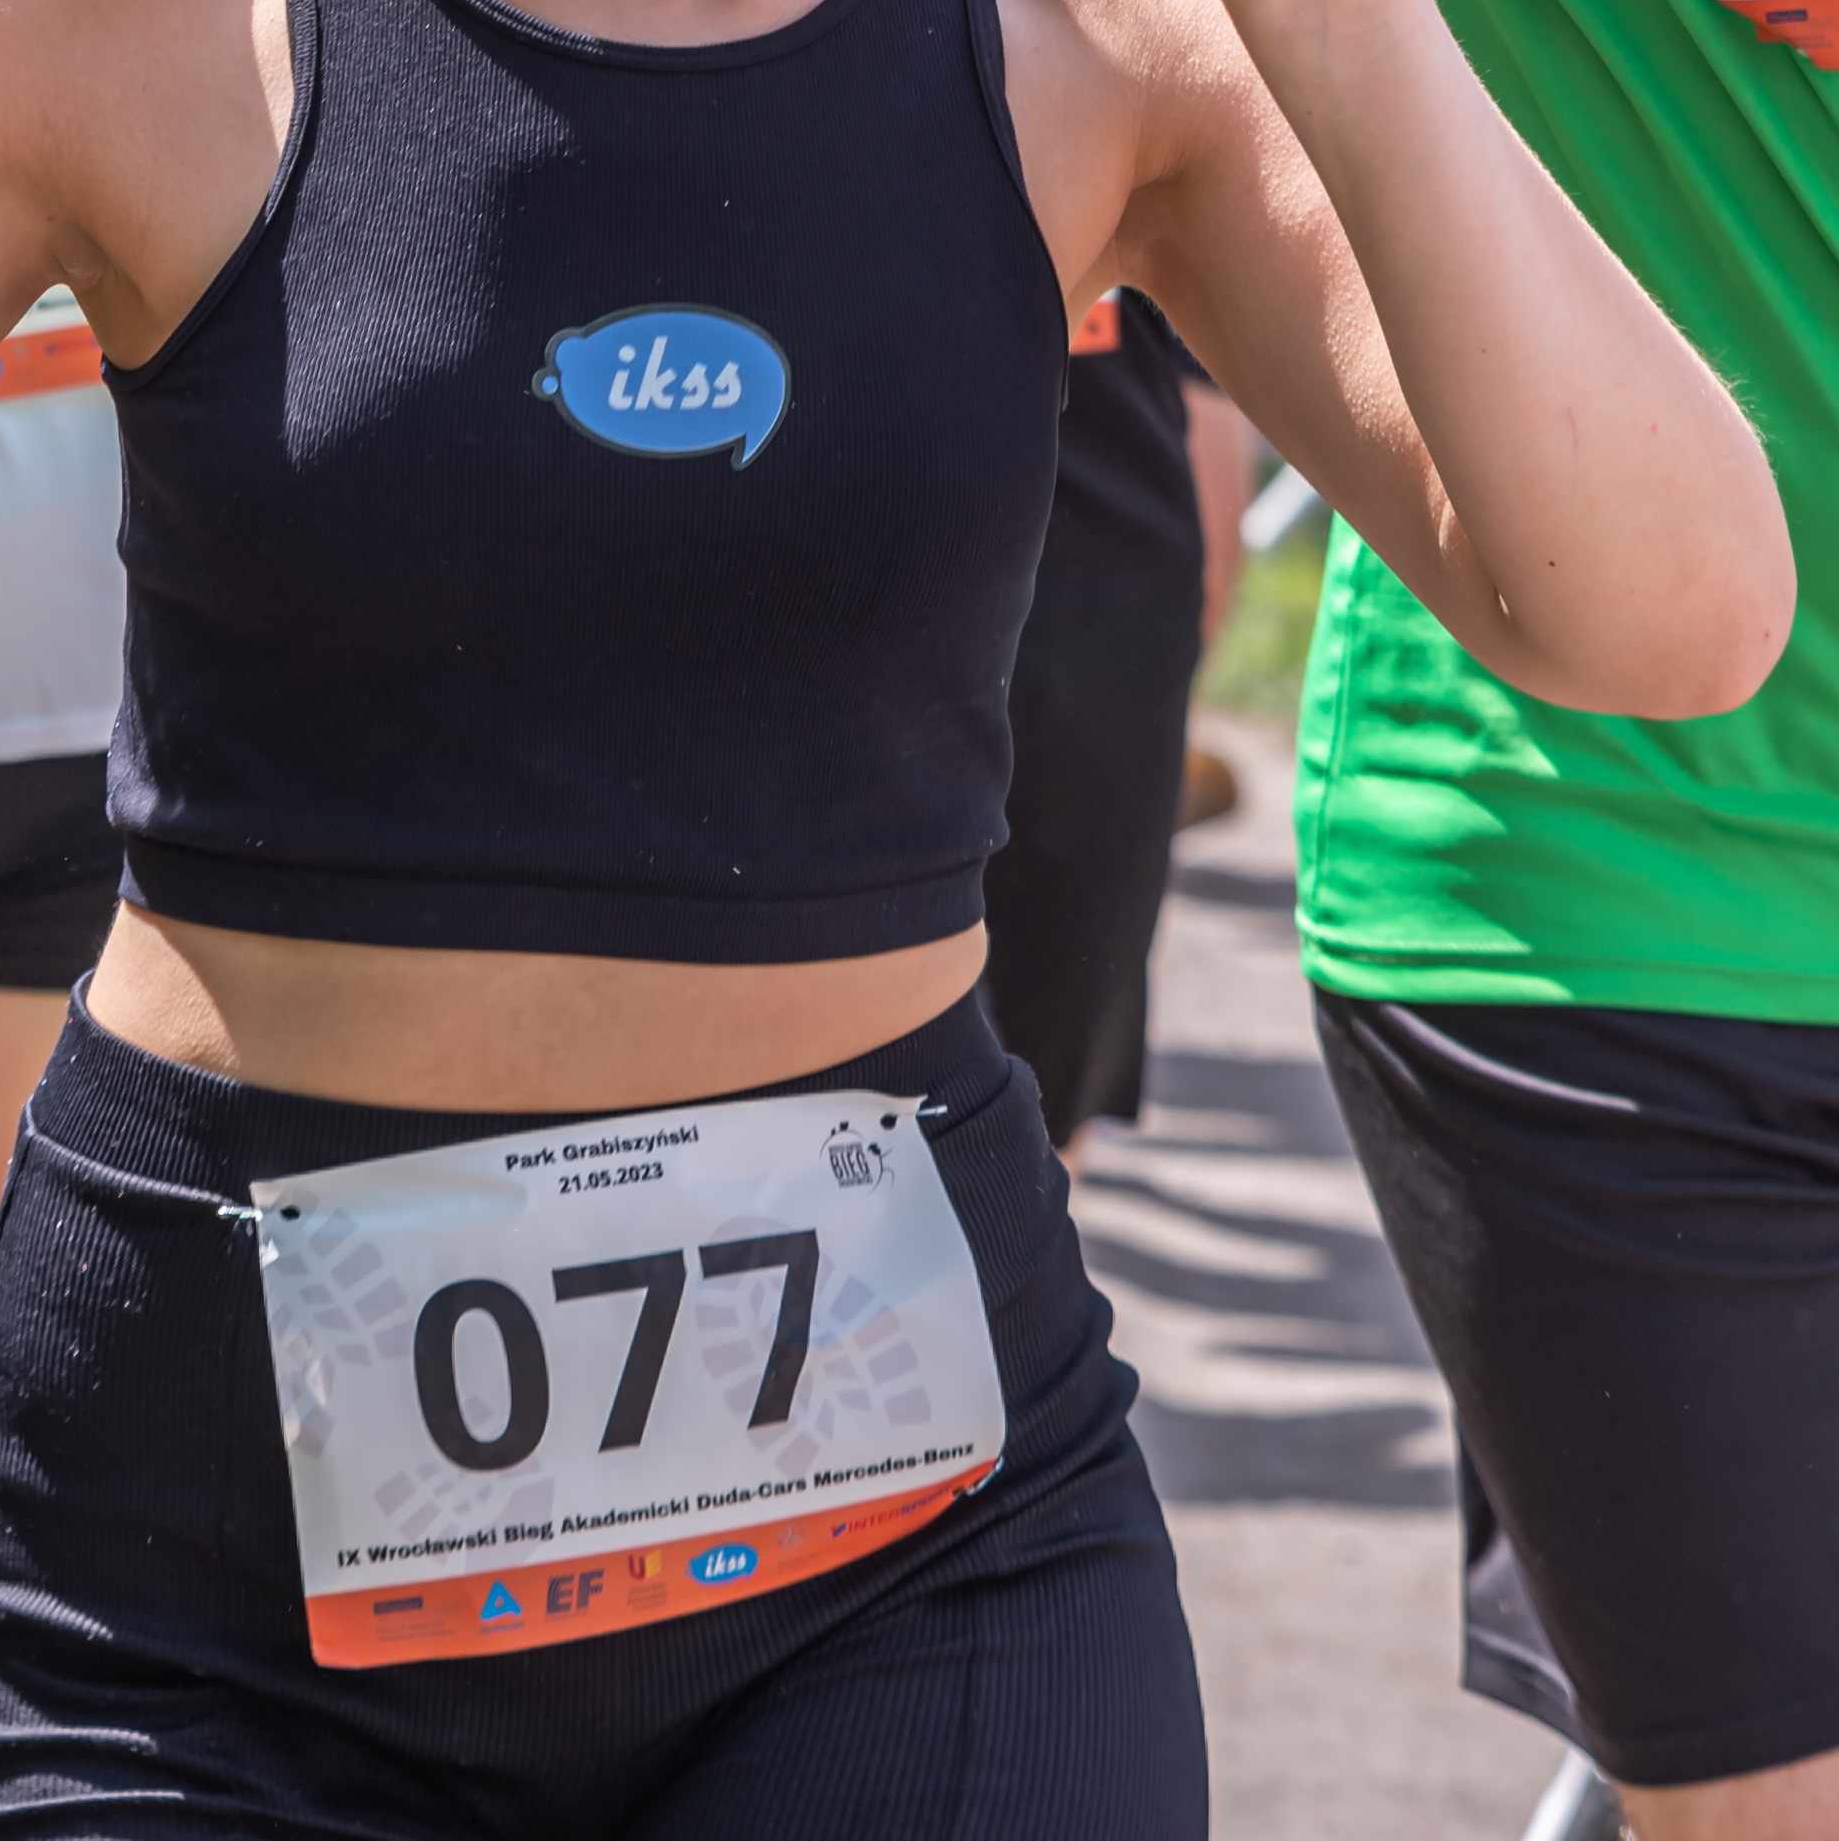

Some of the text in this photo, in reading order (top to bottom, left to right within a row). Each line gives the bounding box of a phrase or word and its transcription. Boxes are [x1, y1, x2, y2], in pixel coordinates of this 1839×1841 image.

[608, 335, 743, 411] ikss
[505, 1124, 700, 1171] Park Grabiszyński
[559, 1162, 664, 1194] 21.05.2023
[413, 1227, 820, 1472] 077
[337, 1443, 975, 1568] IX Wrocławski Bieg Akademicki Duda-Cars Mercedes-Benz
